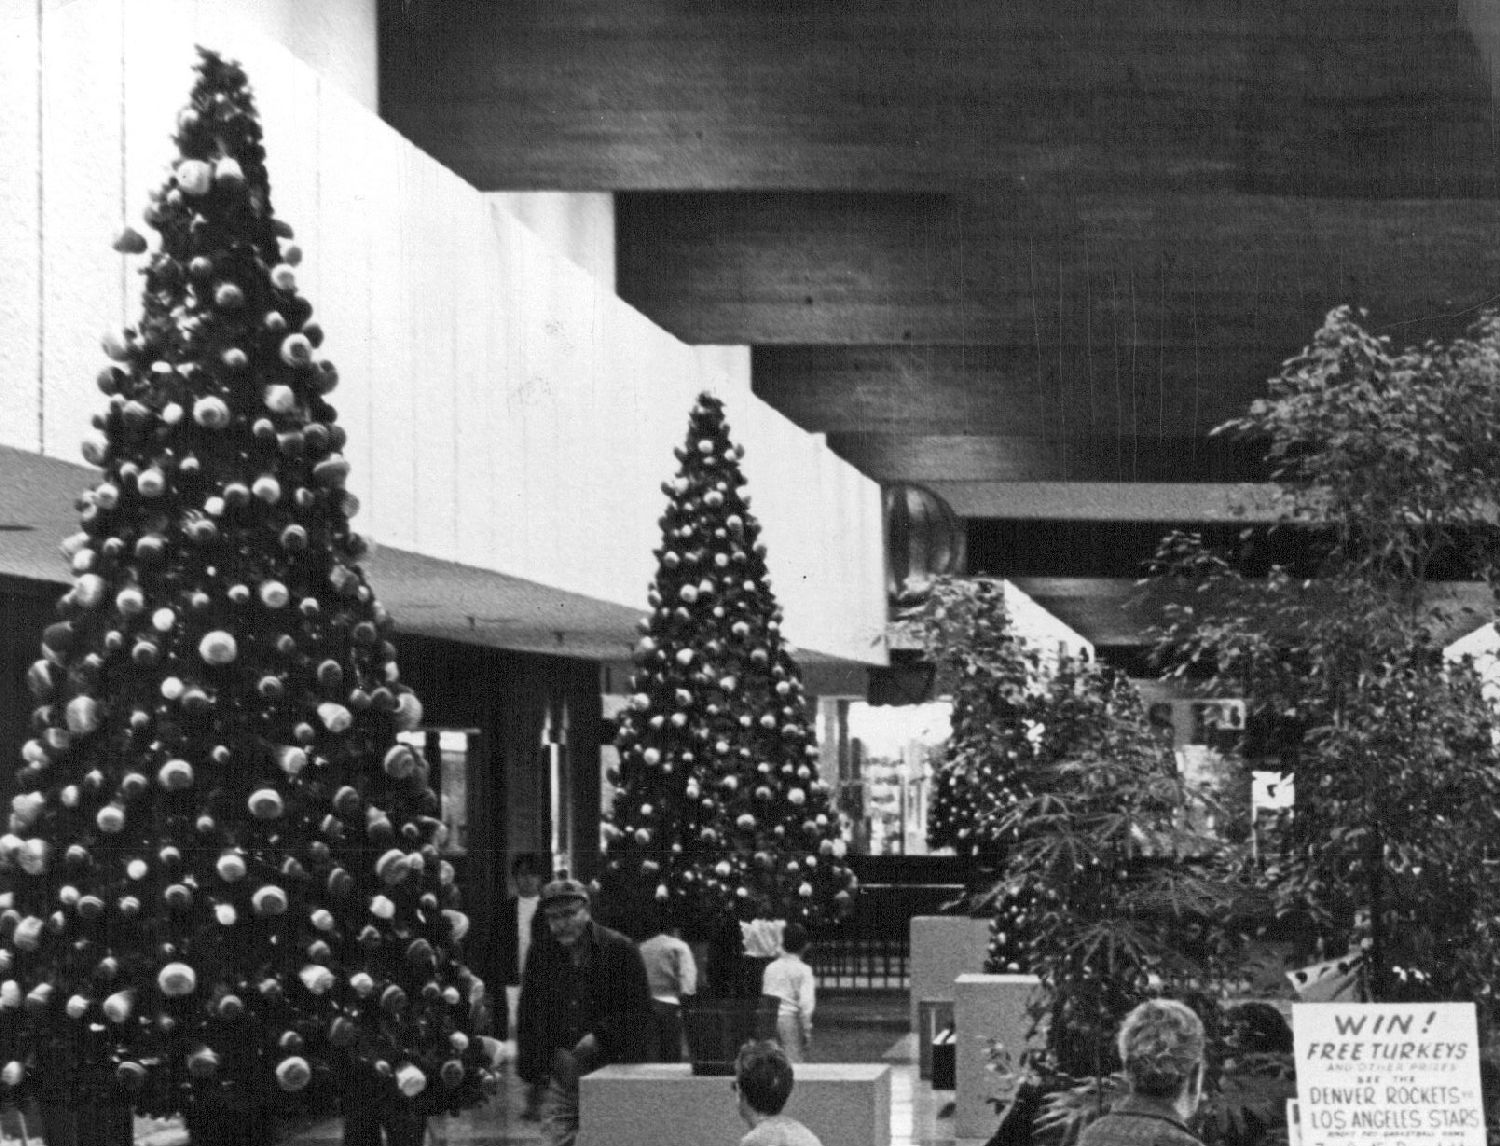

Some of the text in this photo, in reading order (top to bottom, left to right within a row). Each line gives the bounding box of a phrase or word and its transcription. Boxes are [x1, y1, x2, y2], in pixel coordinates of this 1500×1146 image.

[1334, 1010, 1437, 1036] WIN!
[1307, 1042, 1468, 1060] FREE TURKEYS
[1310, 1086, 1376, 1105] DENVER
[1386, 1086, 1460, 1104] ROCKETS
[1310, 1108, 1480, 1130] LOS ANGELES STARS
